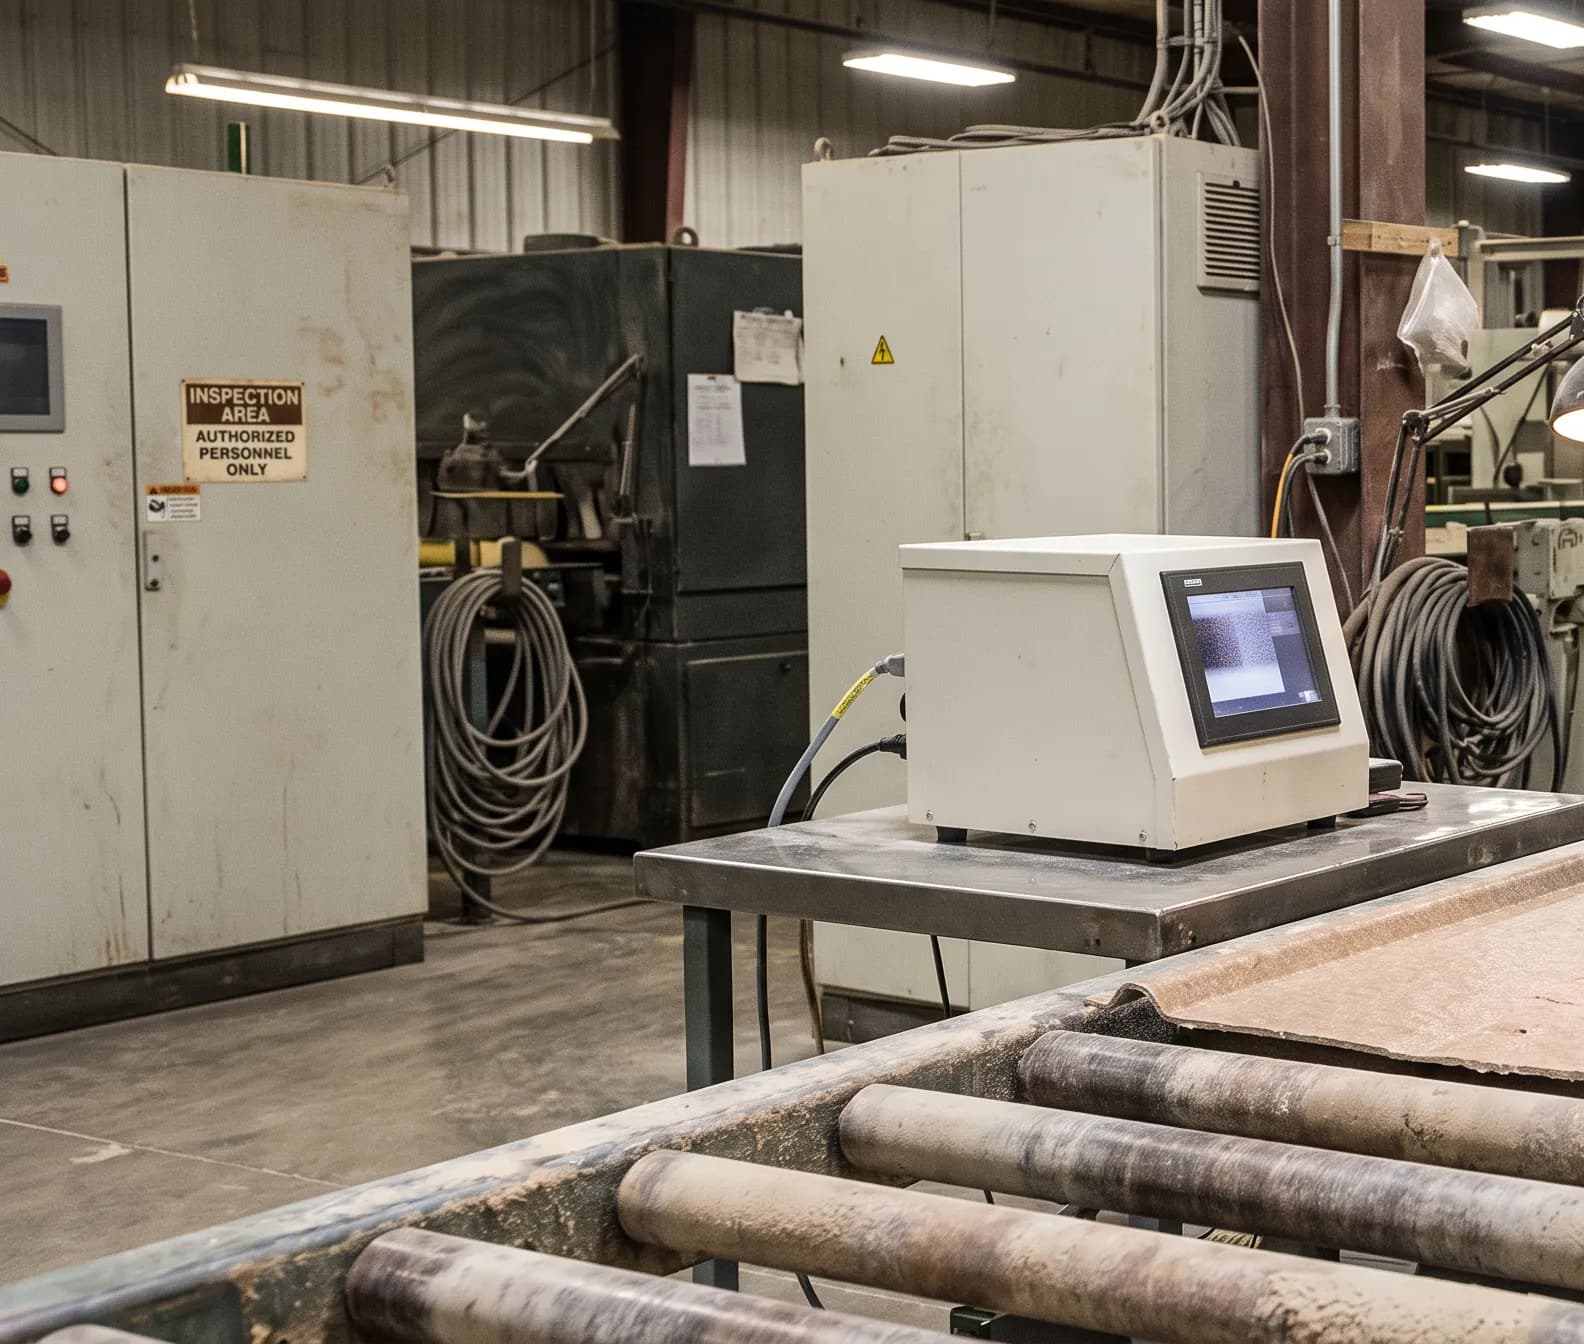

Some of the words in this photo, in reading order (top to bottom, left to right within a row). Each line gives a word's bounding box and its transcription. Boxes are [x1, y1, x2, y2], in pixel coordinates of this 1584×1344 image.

[190, 387, 299, 405] INSPECTION
[221, 406, 270, 423] AREA
[196, 430, 295, 443] AUTHORIZED
[199, 447, 292, 460] PERSONNEL
[226, 463, 268, 476] ONLY
